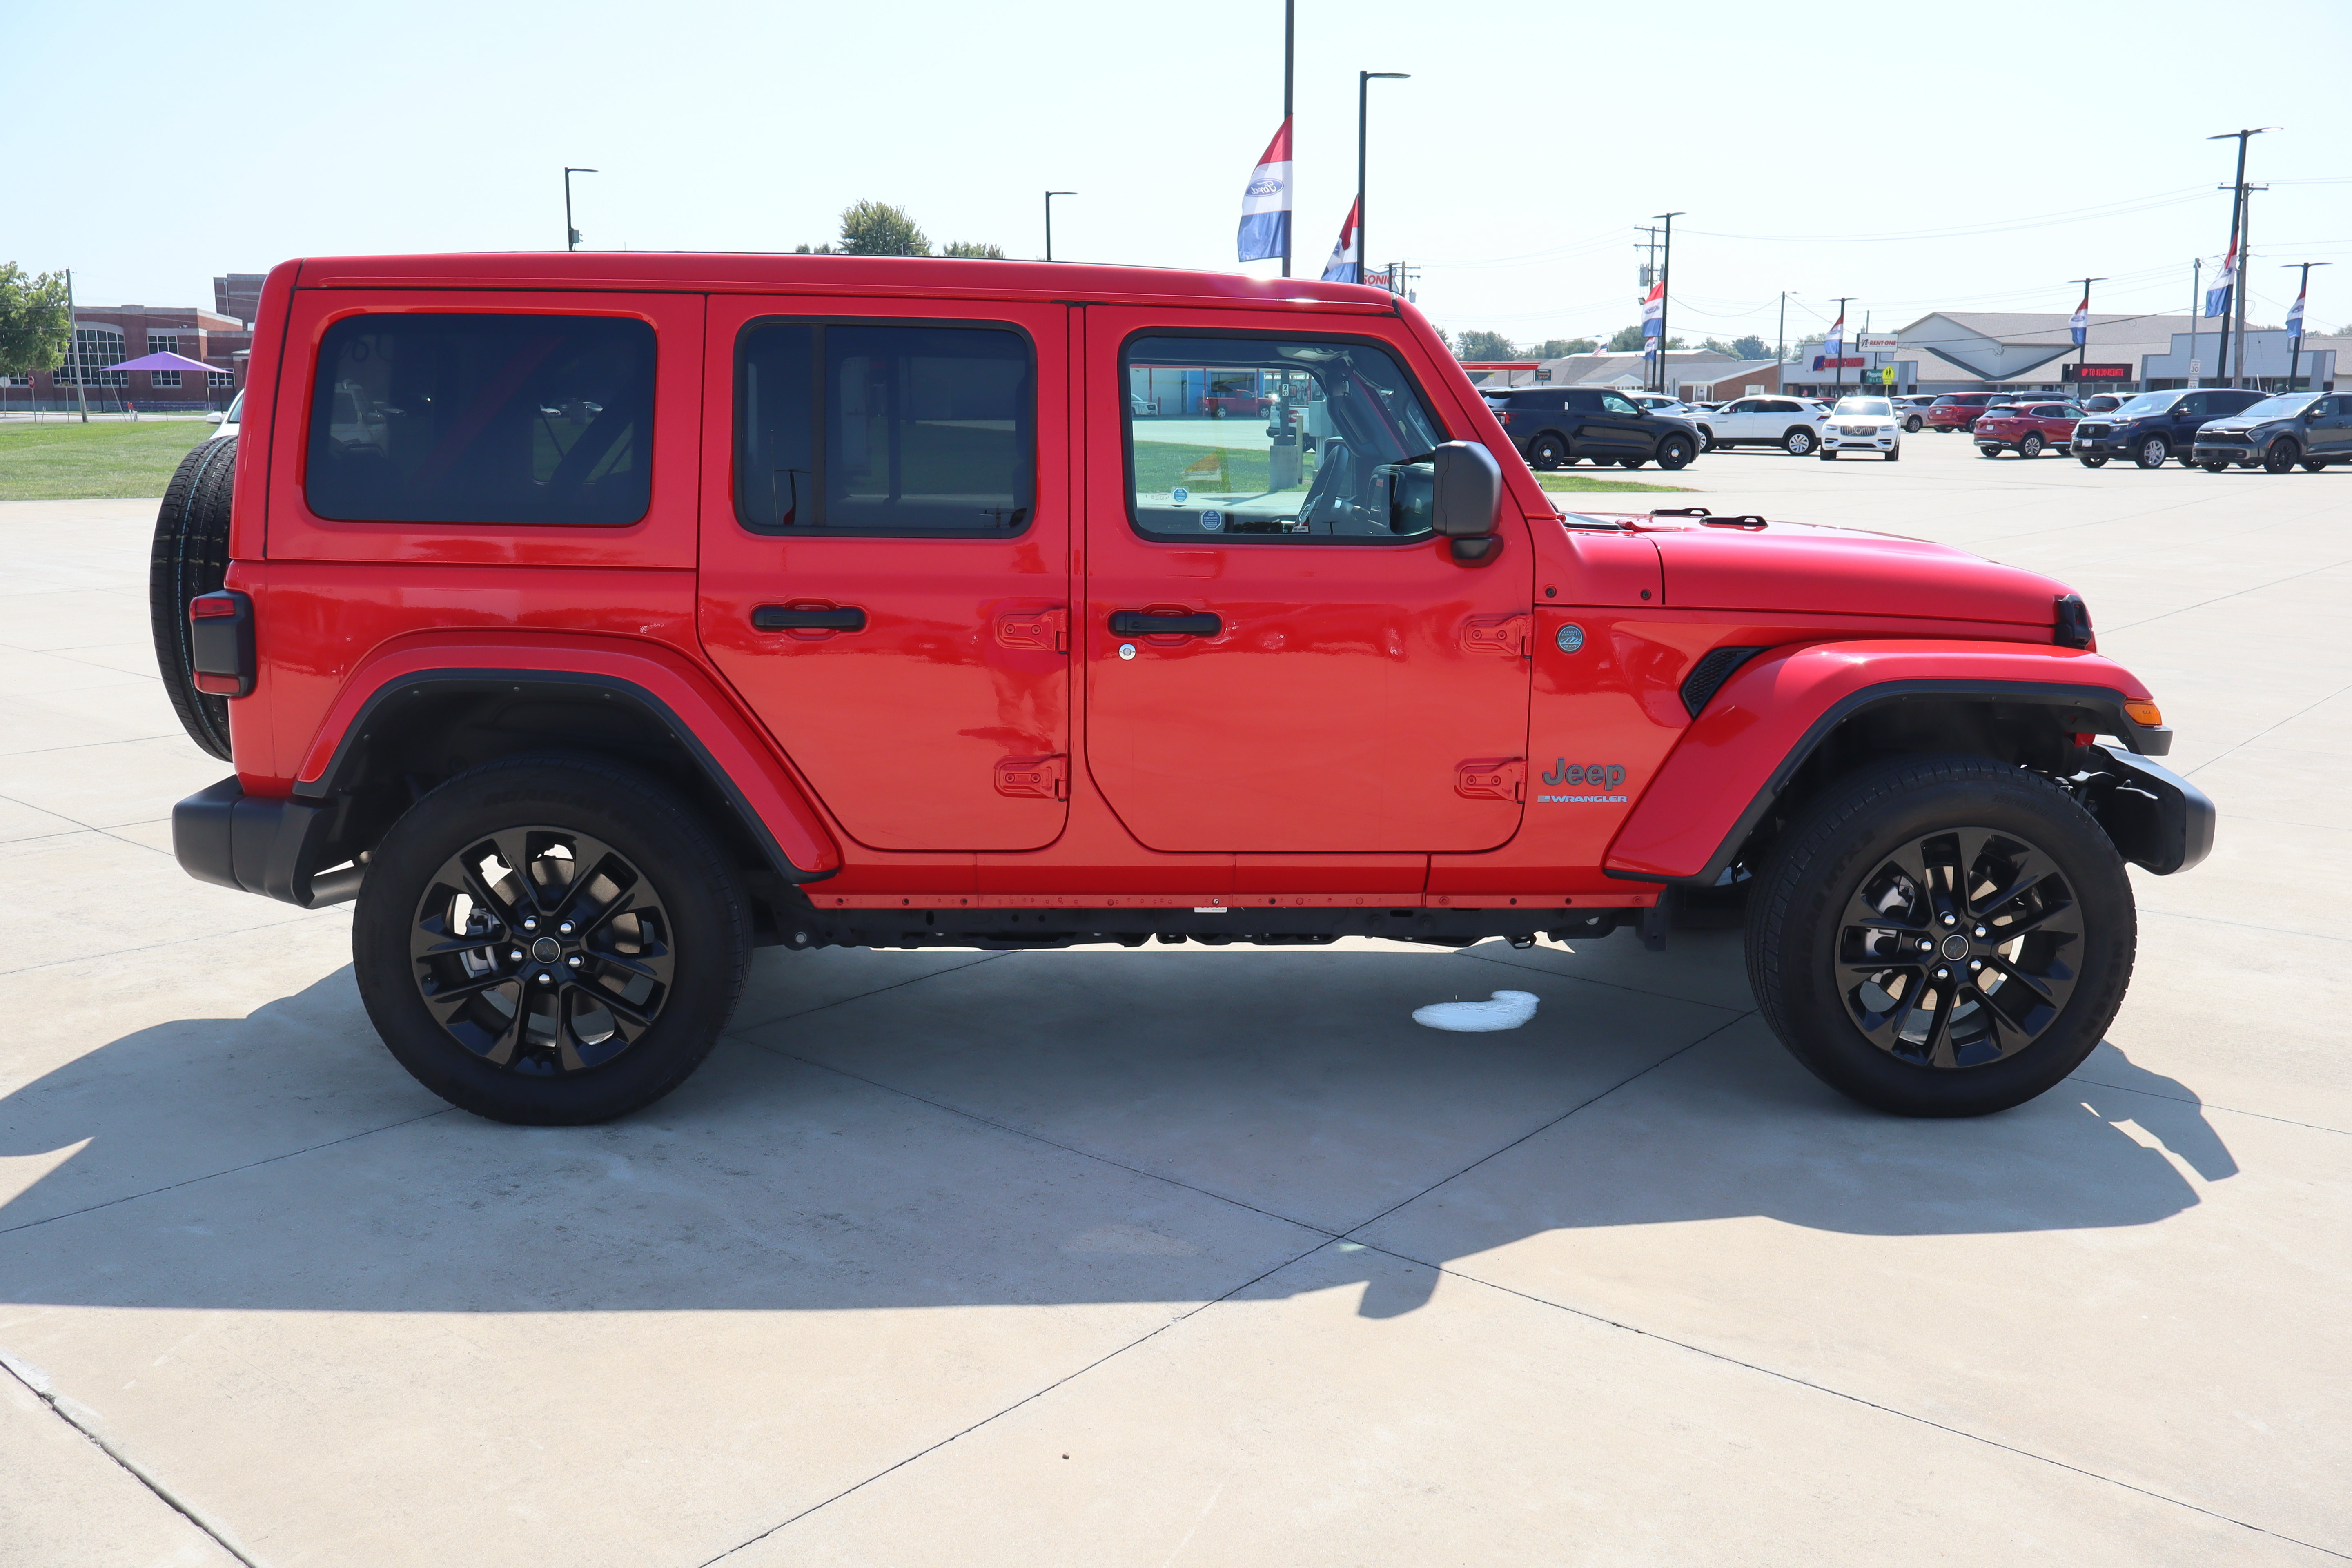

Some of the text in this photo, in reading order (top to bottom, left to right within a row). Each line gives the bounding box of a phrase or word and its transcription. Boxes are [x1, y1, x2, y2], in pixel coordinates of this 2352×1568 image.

[1363, 275, 1394, 285] SONIC
[1846, 357, 1864, 367] ONE
[2082, 368, 2088, 376] UP
[1542, 757, 1626, 791] Jeep
[1991, 794, 2049, 817] 255/60R20
